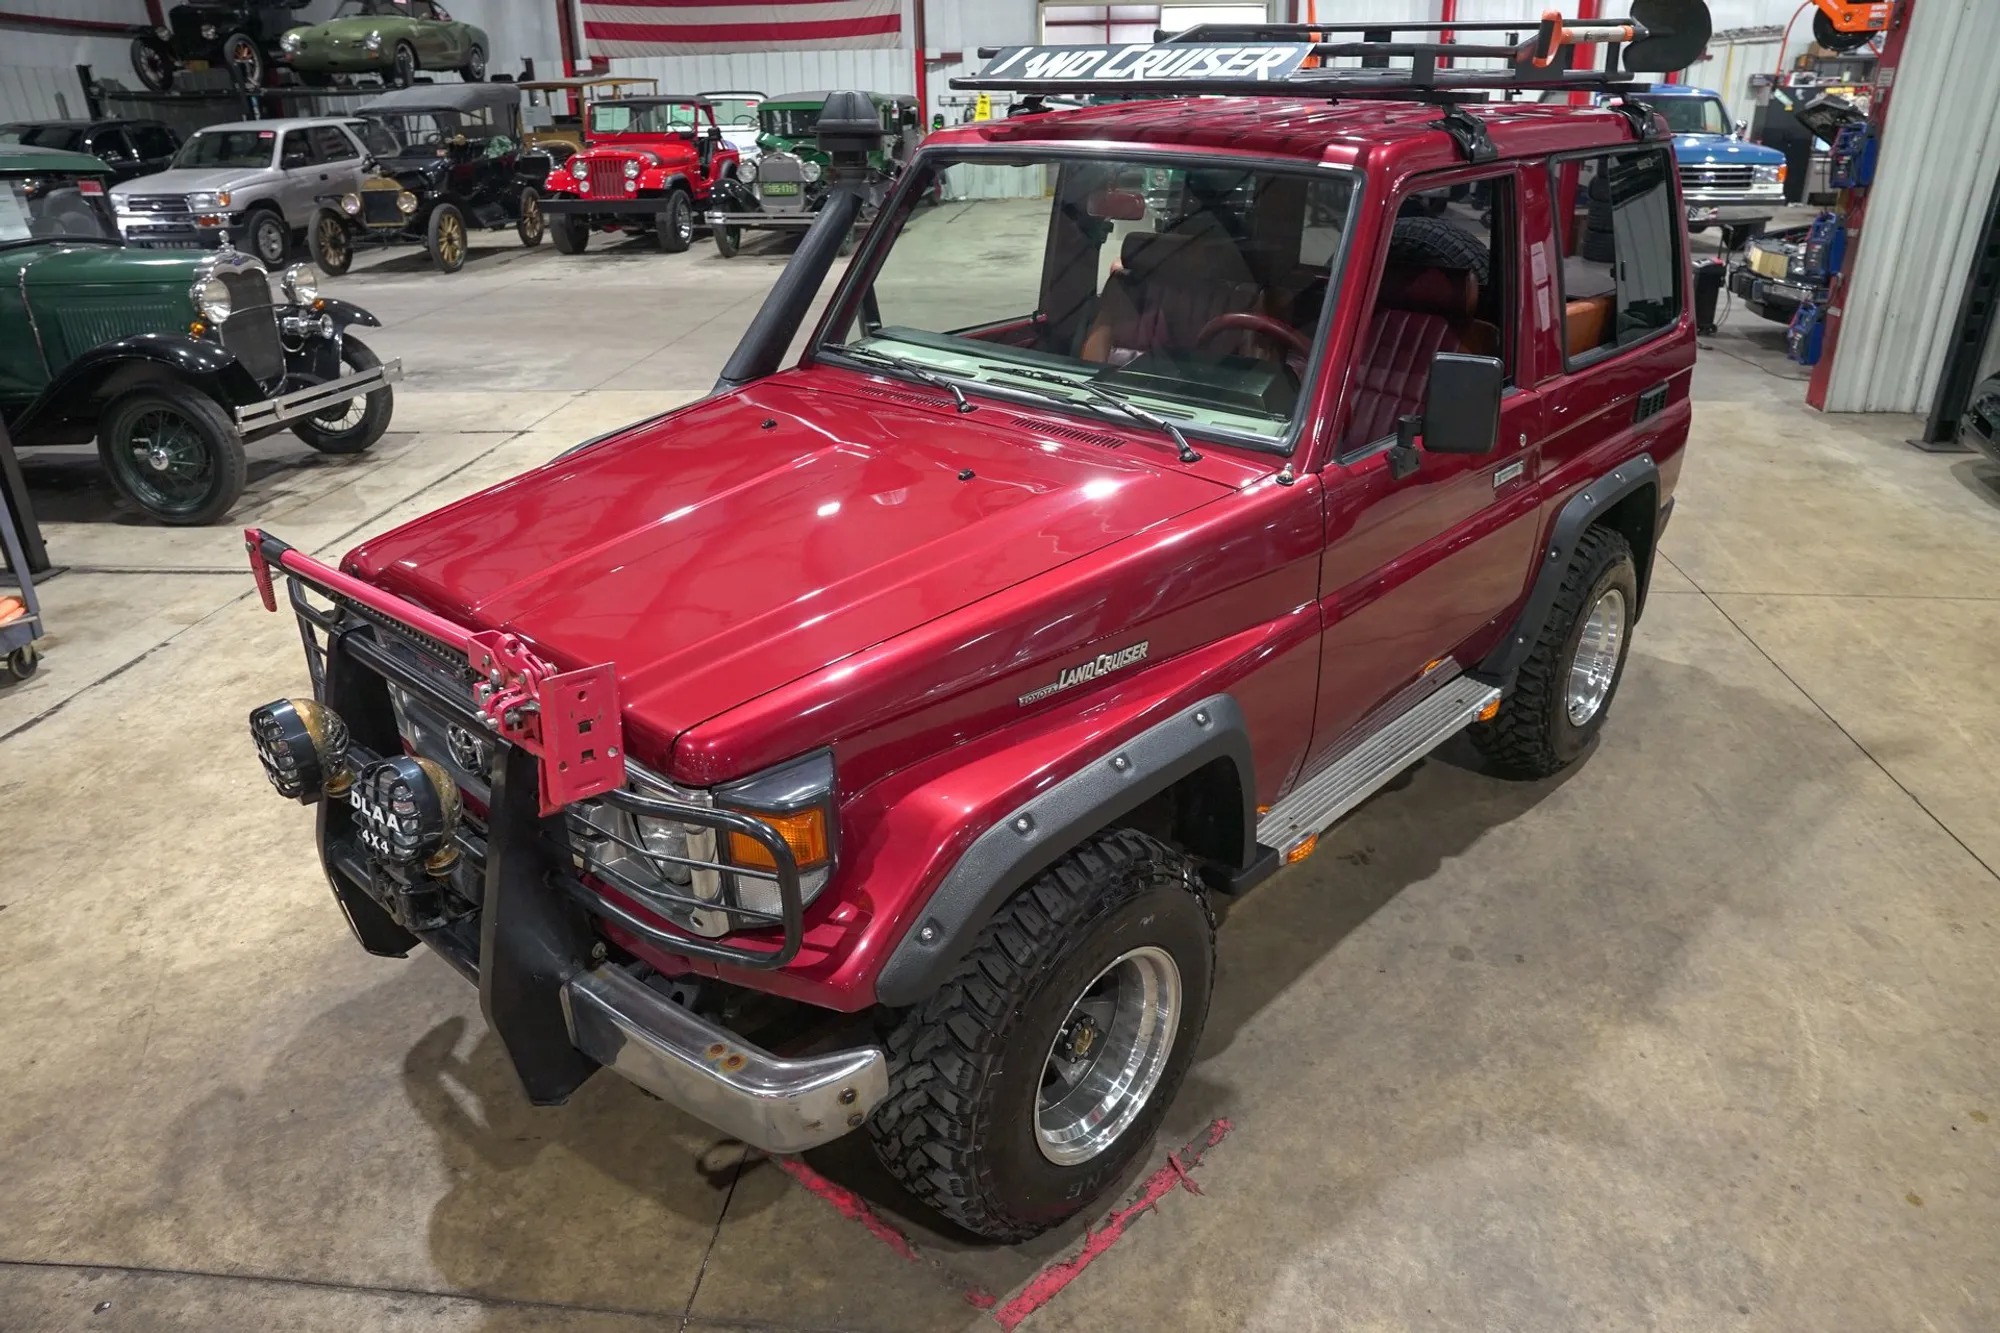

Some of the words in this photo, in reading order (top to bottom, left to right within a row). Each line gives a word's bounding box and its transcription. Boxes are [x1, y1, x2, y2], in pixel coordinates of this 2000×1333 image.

[989, 47, 1107, 78] LAND
[1093, 44, 1298, 80] CRUISER
[1059, 661, 1095, 690] LAND
[1095, 640, 1149, 677] CRUISER
[351, 790, 400, 832] DLAA
[362, 829, 390, 855] 4X4
